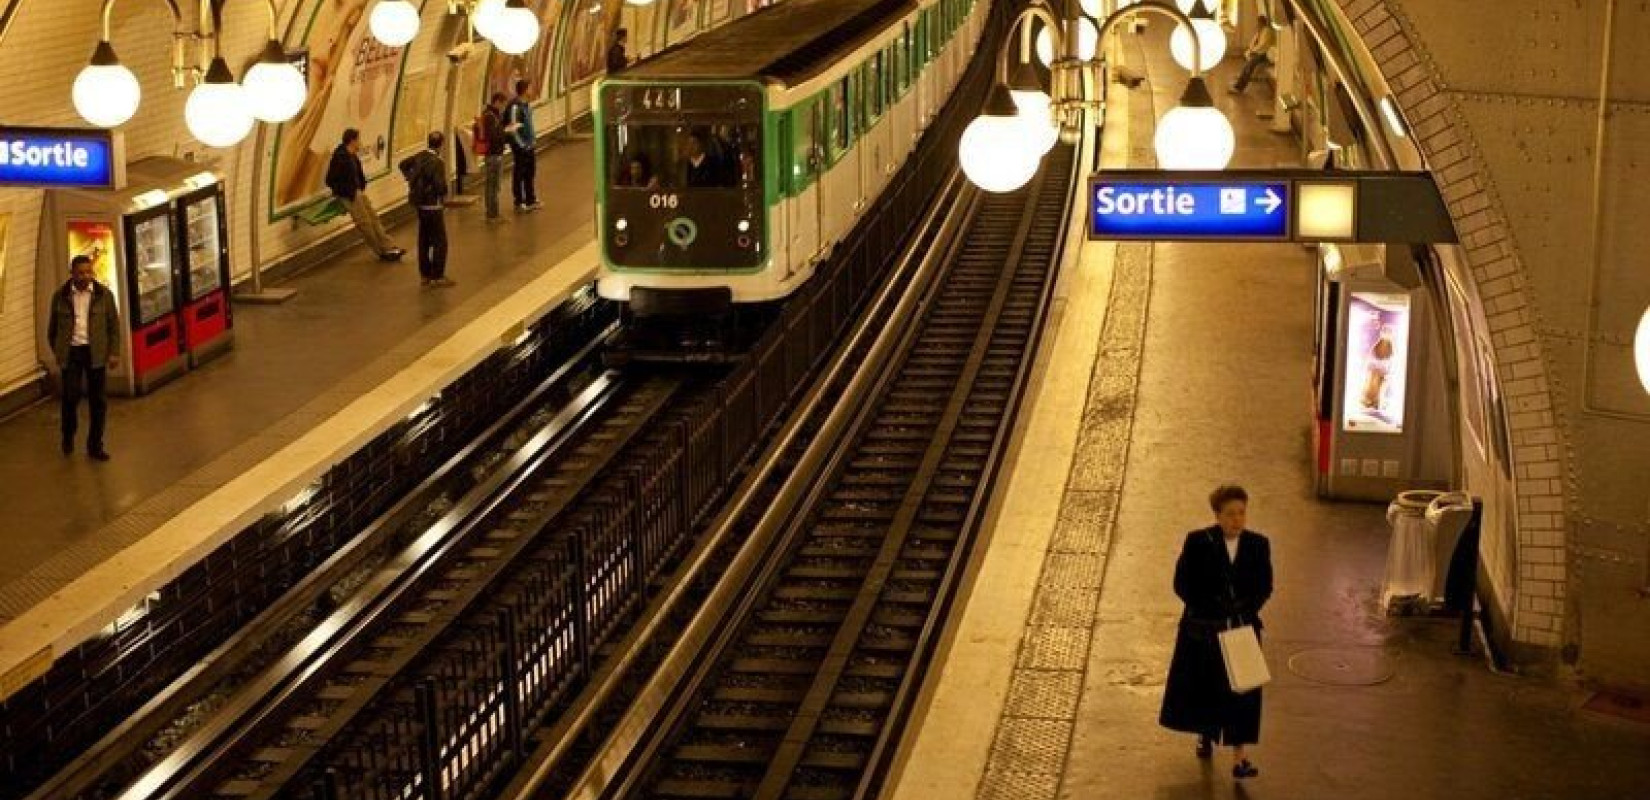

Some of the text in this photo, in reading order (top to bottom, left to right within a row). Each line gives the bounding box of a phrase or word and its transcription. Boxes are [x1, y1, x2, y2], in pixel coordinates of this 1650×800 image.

[11, 140, 88, 167] Sortie
[649, 193, 679, 209] 016
[1096, 186, 1195, 215] Sortie
